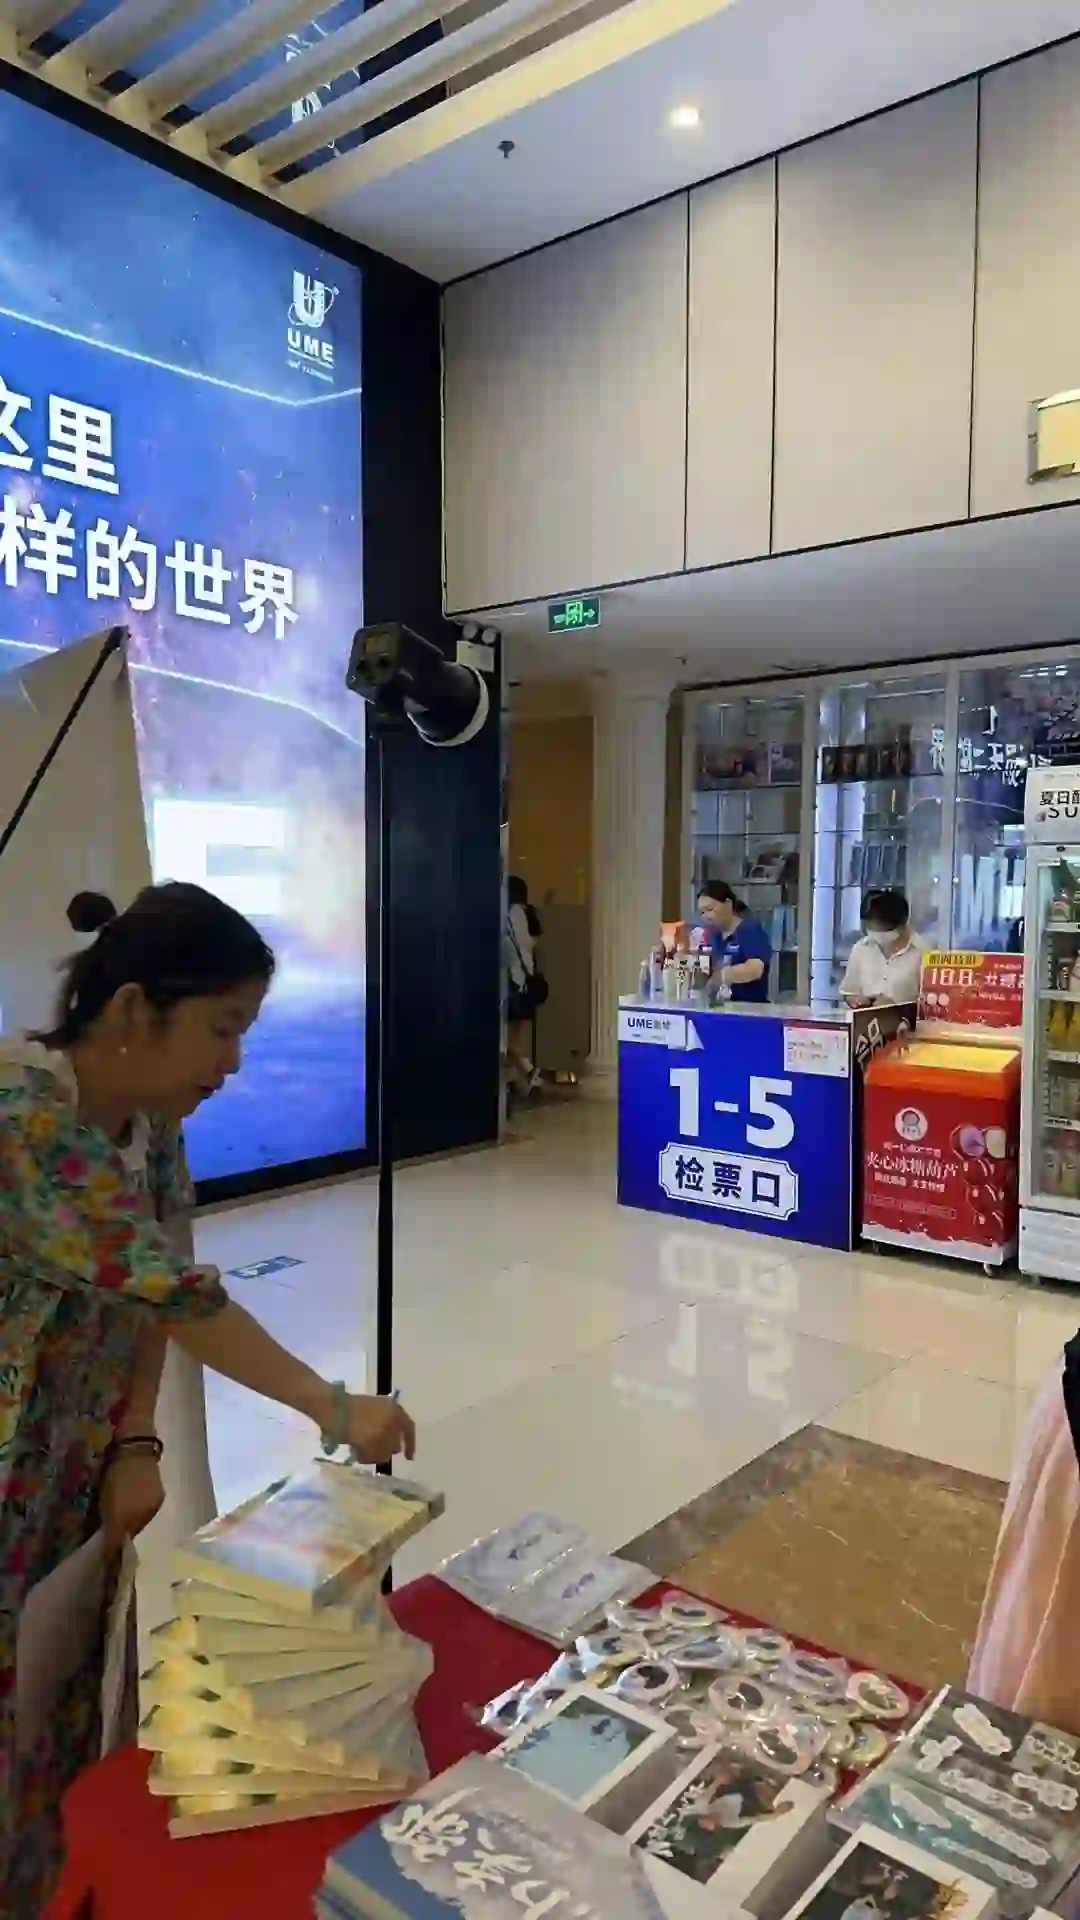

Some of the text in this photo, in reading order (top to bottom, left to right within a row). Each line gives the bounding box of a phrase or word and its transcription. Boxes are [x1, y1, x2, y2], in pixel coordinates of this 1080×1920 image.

[287, 327, 334, 363] UME
[0, 494, 299, 640] 样的世界
[669, 1067, 795, 1149] 1-5
[674, 1154, 781, 1208] 检票口
